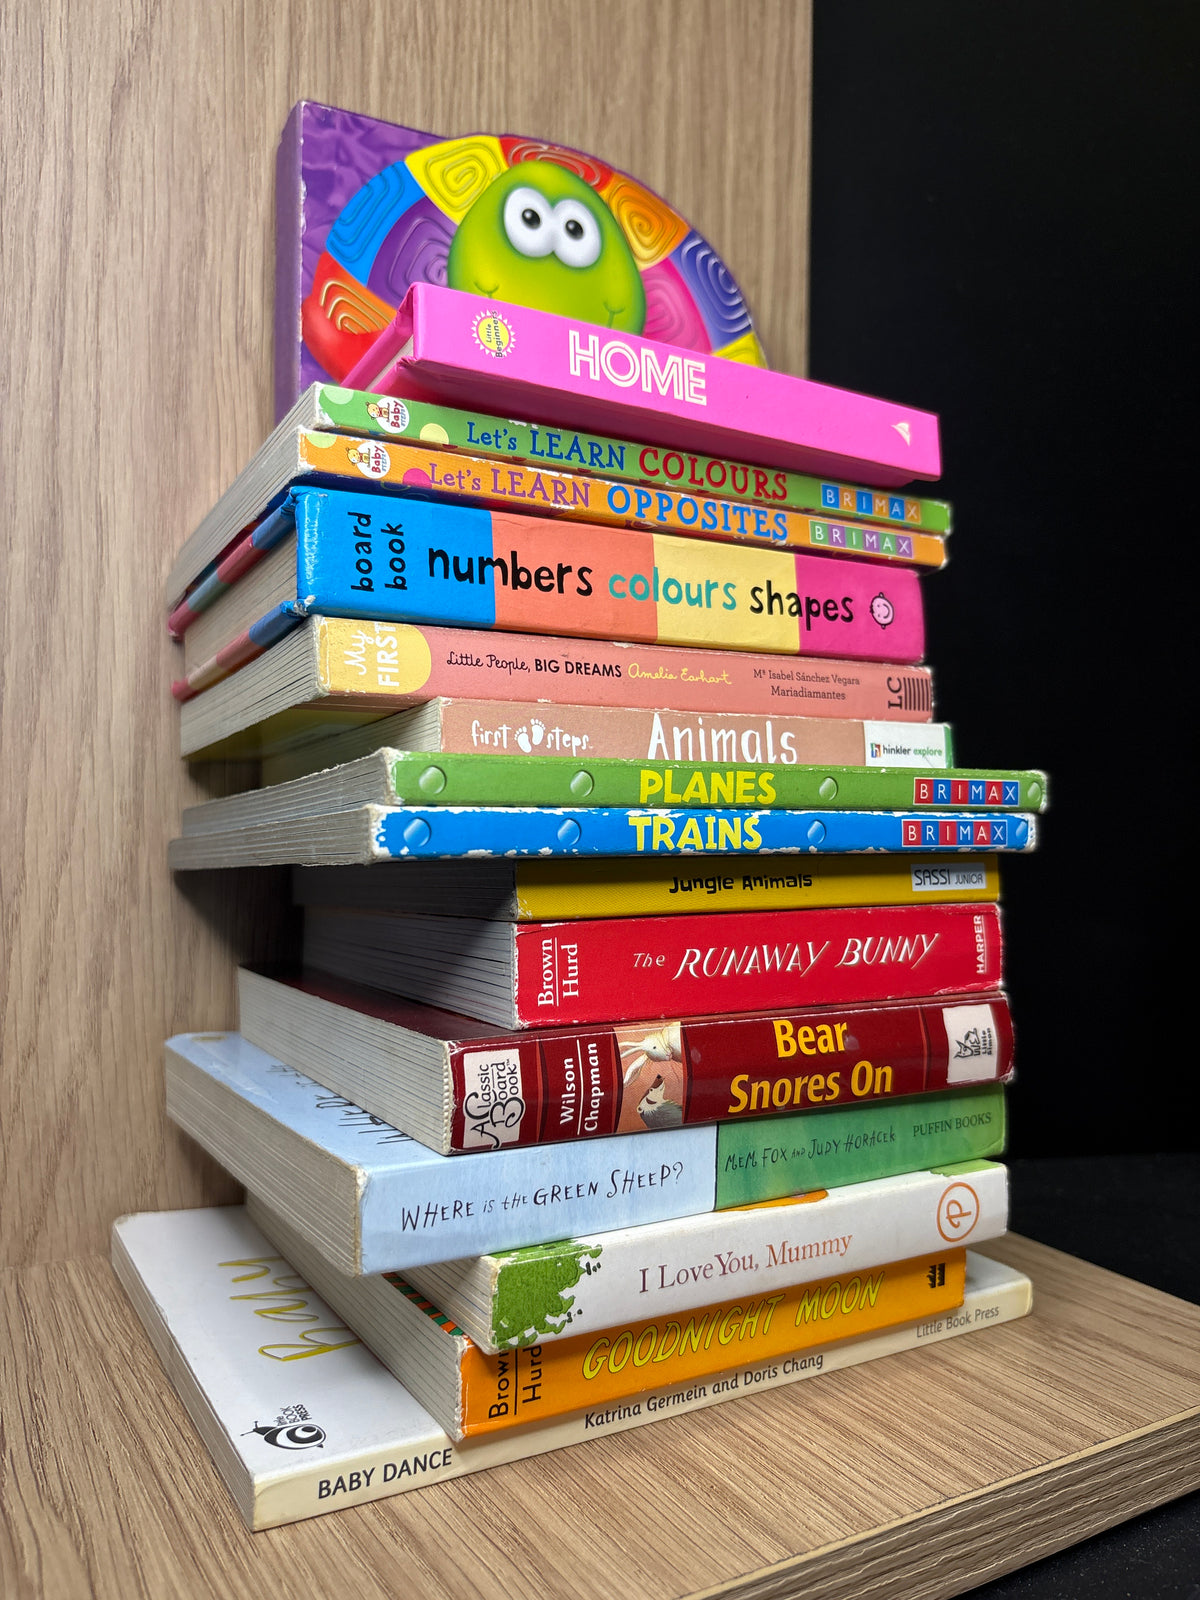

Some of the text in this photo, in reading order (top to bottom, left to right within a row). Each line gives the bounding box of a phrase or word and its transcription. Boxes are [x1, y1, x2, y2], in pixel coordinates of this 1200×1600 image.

[491, 310, 504, 358] Beginners
[568, 330, 707, 406] HOME
[390, 400, 405, 428] Baby
[371, 445, 386, 474] Baby
[467, 421, 788, 501] Let's LEARN COLOURS
[428, 462, 788, 541] Let's LEARN OPPOSITES
[823, 486, 920, 521] BRIMAX
[348, 511, 374, 593] board
[381, 522, 408, 591] book
[813, 524, 912, 556] BRIMAX
[428, 547, 854, 631] numbers colours shapes
[343, 629, 375, 676] My
[374, 621, 400, 687] FIRST
[446, 651, 732, 685] Little People, BIG DREAMS Amelia Earhart
[768, 670, 794, 681] Isabel
[795, 671, 830, 684] Sánchez
[831, 674, 860, 687] Vegara
[770, 685, 846, 700] Mariadiamantes
[886, 676, 903, 710] LC
[471, 719, 512, 749] first
[545, 726, 590, 757] steps
[647, 712, 798, 765] Animals
[882, 744, 943, 757] hinkler explore
[639, 769, 777, 804] PLANES
[917, 780, 1017, 803] BRIMAX
[627, 816, 763, 852] TRAINS
[905, 822, 1006, 844] BRIMAX
[669, 872, 813, 894] Jungle Animals
[914, 868, 984, 887] SASSI JUNIOR
[633, 932, 940, 981] The RUNAWAY BUNNY
[974, 914, 985, 974] HARPER
[537, 938, 555, 1007] Brown
[560, 943, 579, 998] Hurd
[772, 1018, 848, 1059] Bear
[464, 1063, 491, 1121] Classic
[559, 1057, 577, 1125] Wilson
[584, 1042, 605, 1132] Chapman
[727, 1060, 894, 1114] Snores On
[912, 1111, 992, 1138] PUFFIN BOOKS
[761, 1147, 788, 1168] FOX
[791, 1148, 806, 1159] AND
[807, 1138, 842, 1160] JUDY
[401, 1199, 475, 1232] WHERE
[533, 1181, 600, 1207] GREEN
[606, 1161, 684, 1199] SHEEP?
[639, 1234, 853, 1294] I Love You, Mummy
[582, 1272, 885, 1380] GOODNIGHT MOON
[915, 1304, 1000, 1339] Little Book Press
[522, 1344, 543, 1404] Hurd
[584, 1354, 824, 1430] Katrina Germein and Doris Chang
[318, 1448, 453, 1500] BABY DANCE
